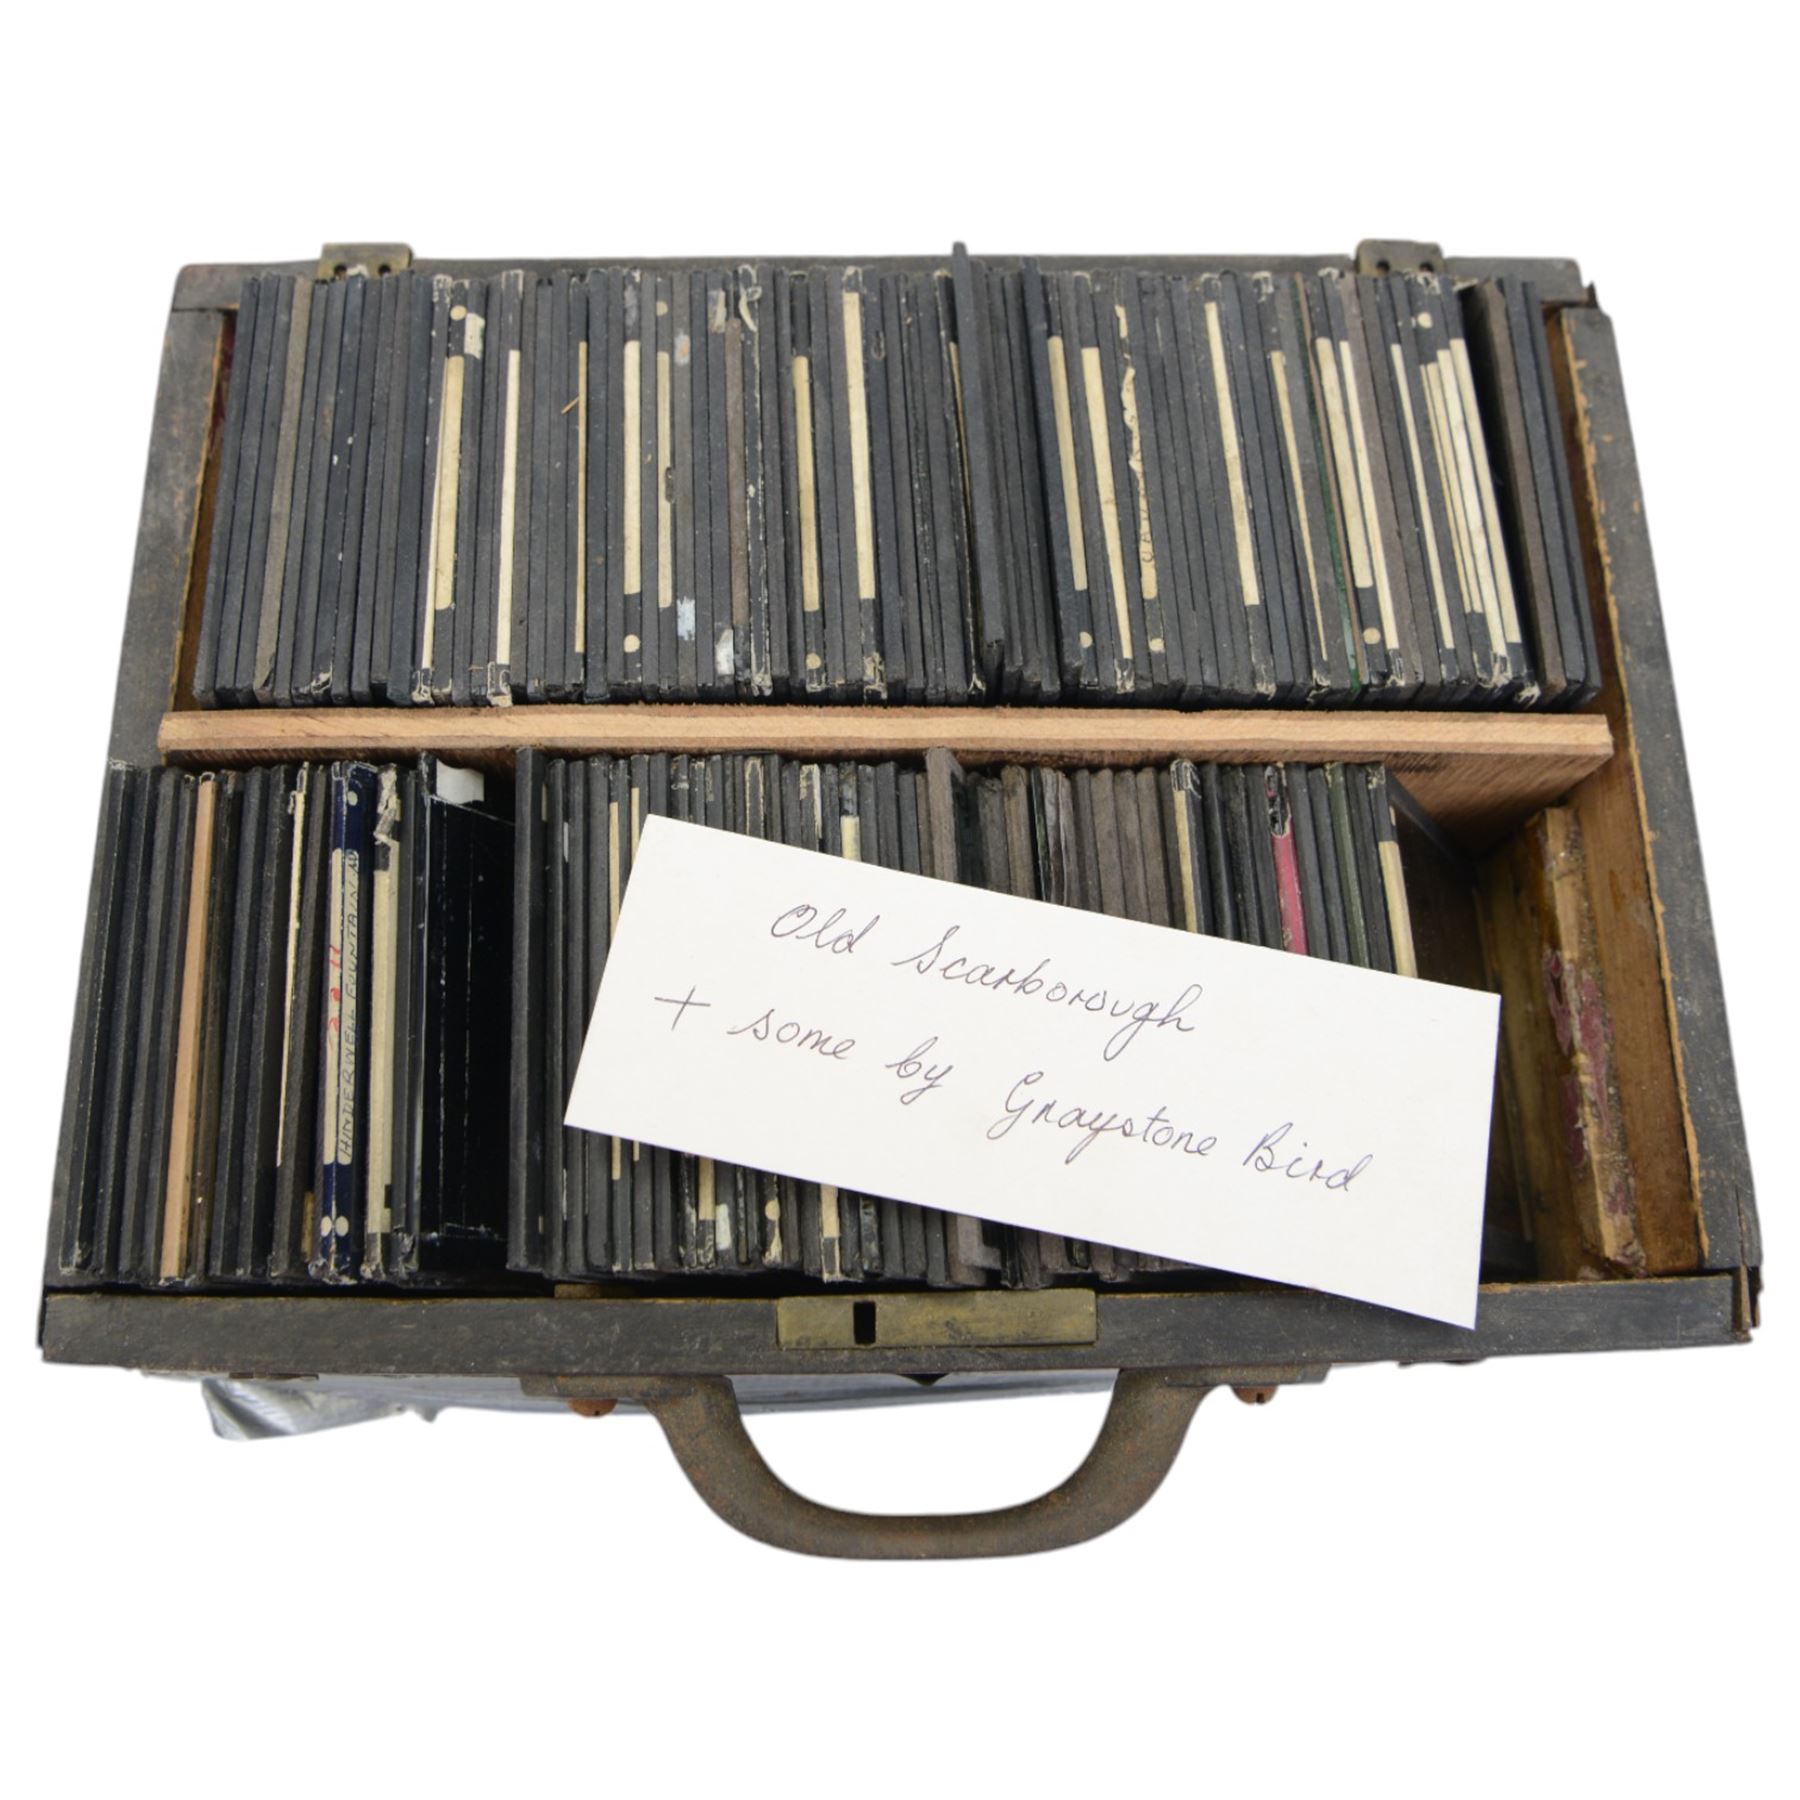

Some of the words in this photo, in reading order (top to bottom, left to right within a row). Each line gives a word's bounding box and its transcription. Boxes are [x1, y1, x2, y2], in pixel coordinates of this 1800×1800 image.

[771, 904, 881, 954] Old
[892, 925, 1203, 1062] Scarborough
[340, 1008, 356, 1158] HINDERWELL
[654, 986, 711, 1030] +
[727, 1008, 856, 1060] some
[885, 1036, 953, 1106] by
[986, 1071, 1218, 1165] Graystone
[1242, 1122, 1374, 1192] Bird
